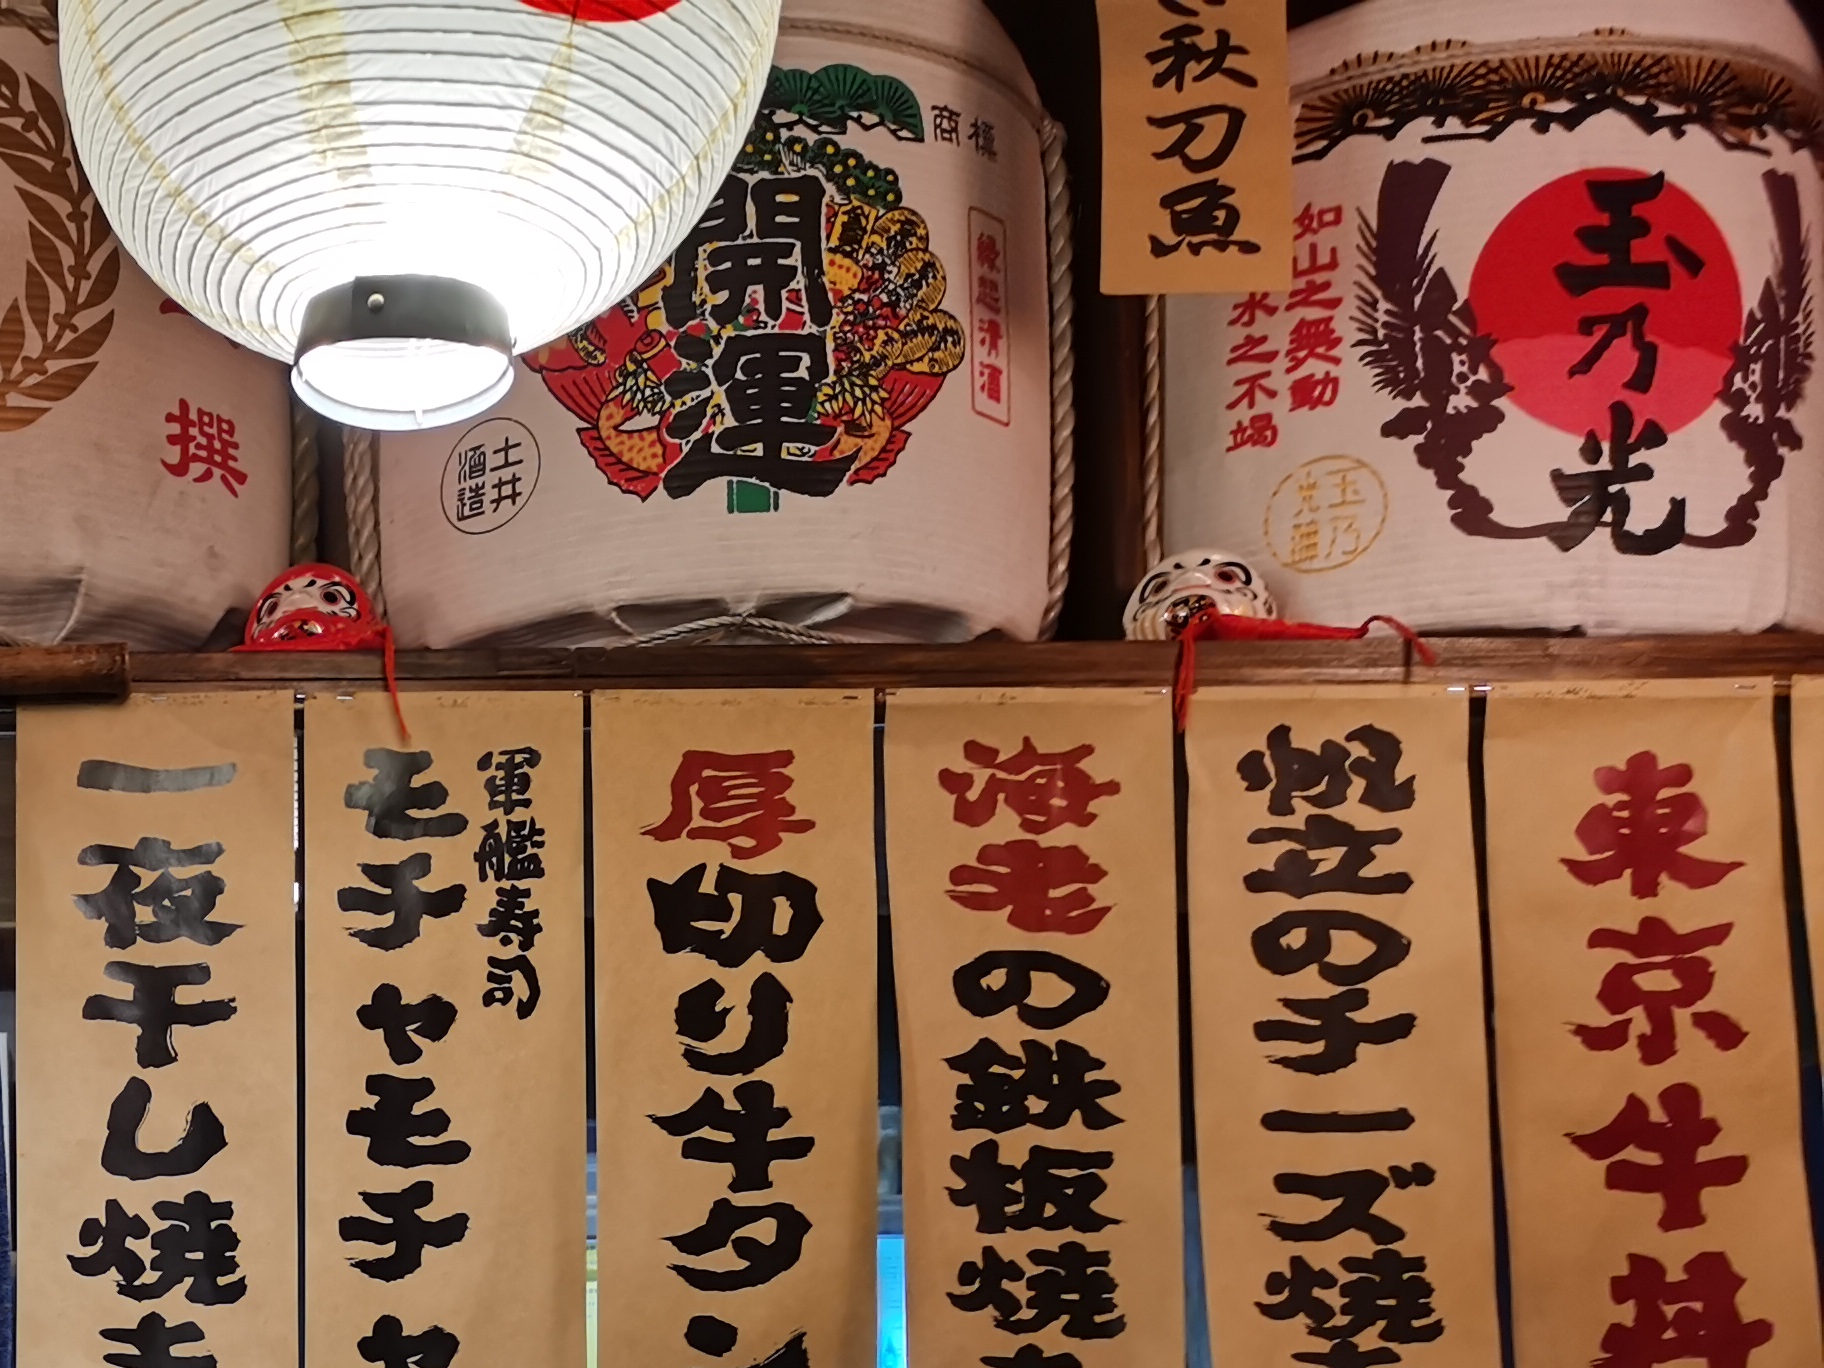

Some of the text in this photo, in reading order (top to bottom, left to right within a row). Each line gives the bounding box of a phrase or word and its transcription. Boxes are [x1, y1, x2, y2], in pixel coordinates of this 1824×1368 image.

[1144, 0, 1261, 258] 秋刀魚
[662, 173, 862, 500] 開運
[1226, 292, 1280, 453] 水之不竭
[1547, 171, 1706, 556] 玉乃光
[474, 746, 546, 1021] 軍艦寿司
